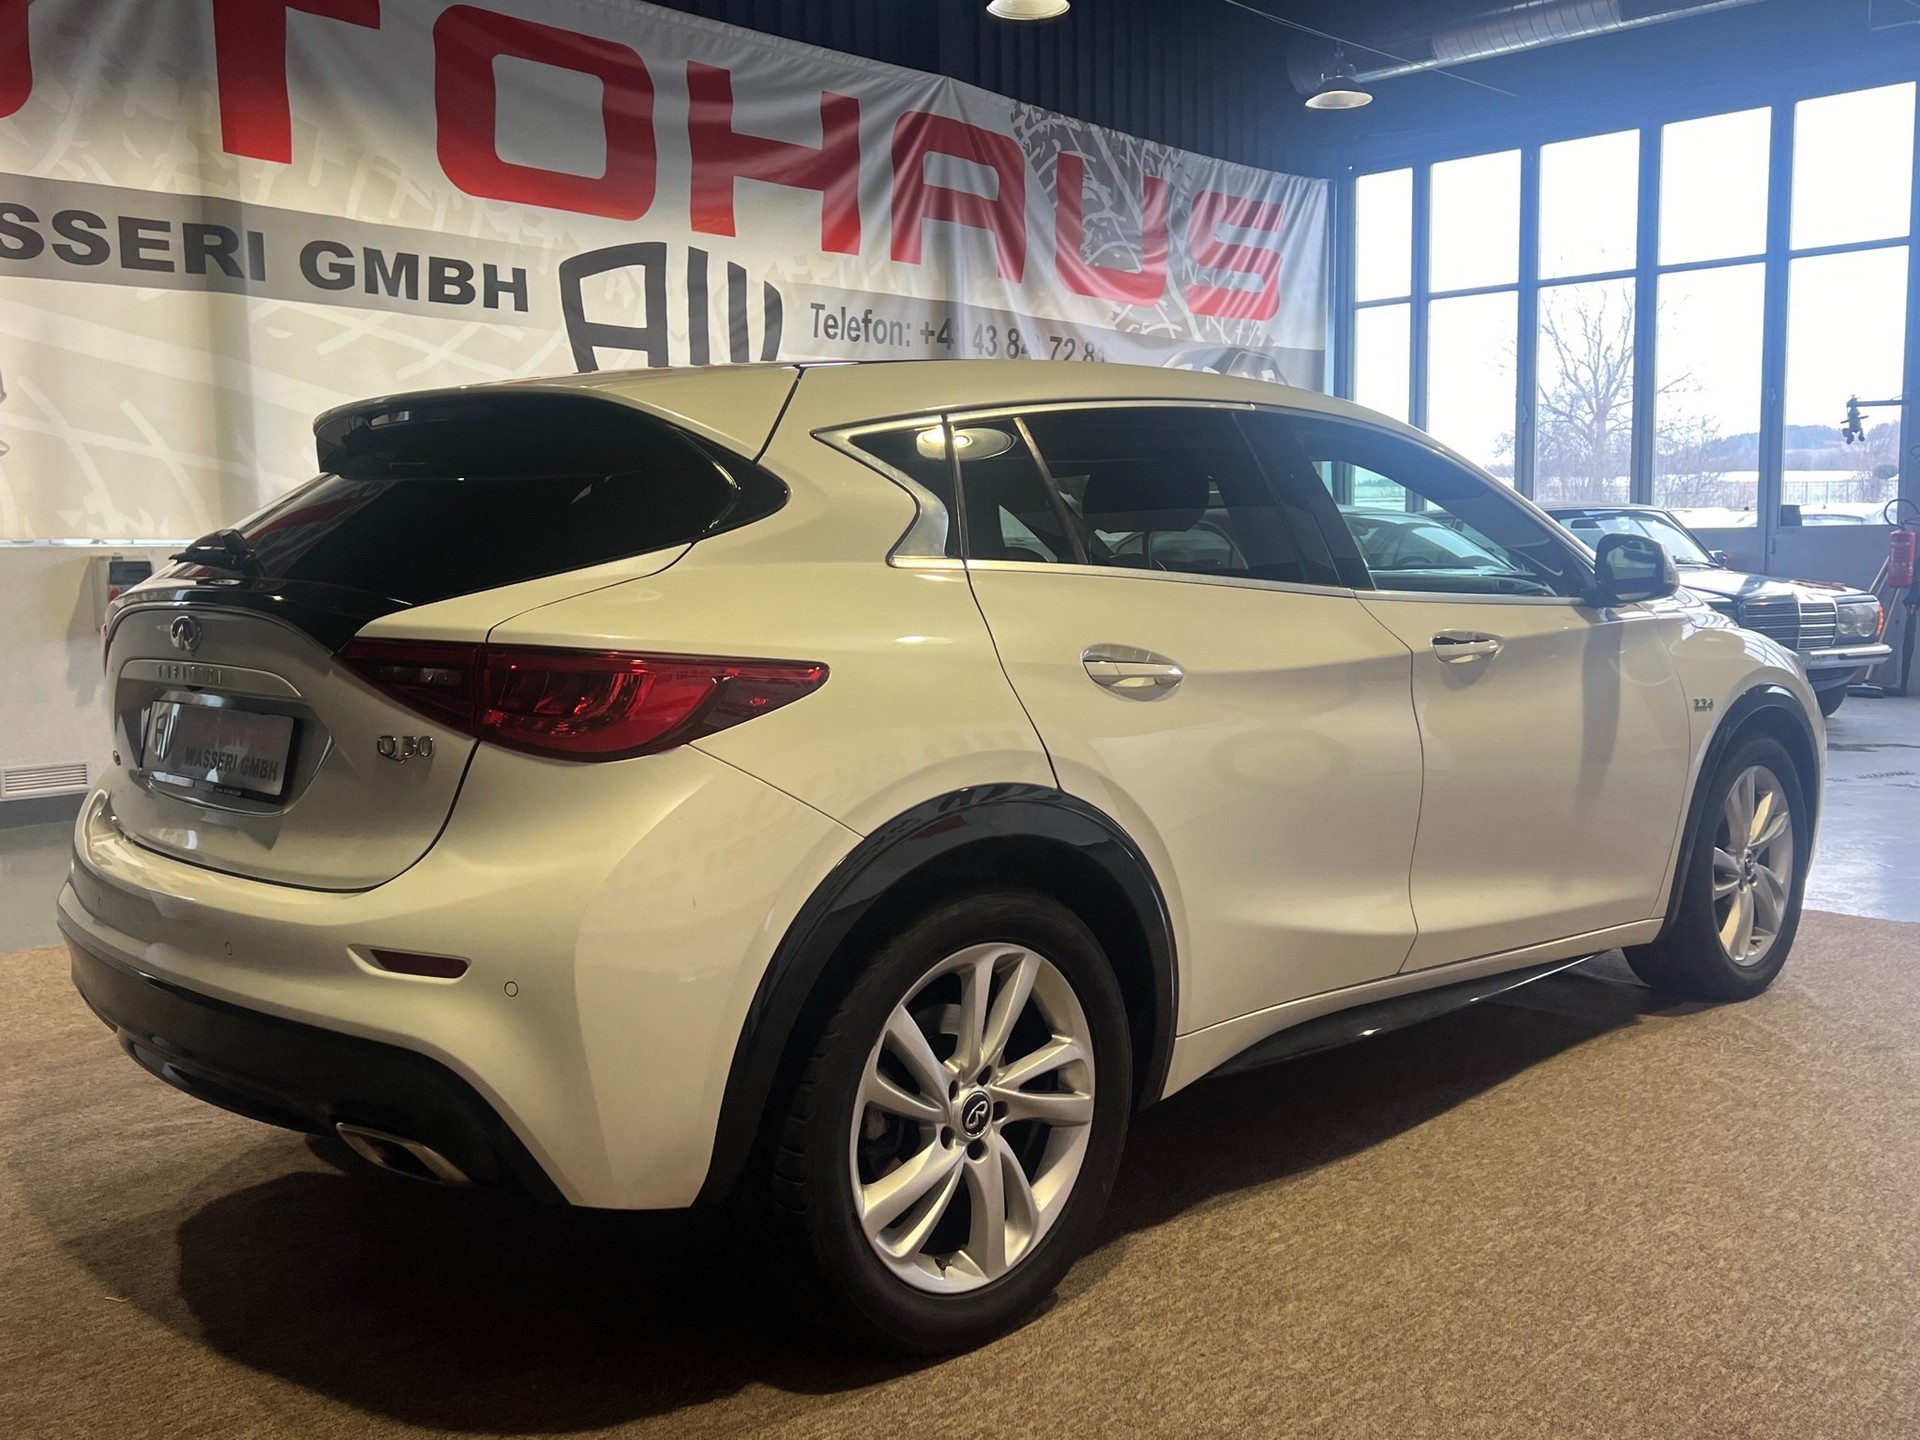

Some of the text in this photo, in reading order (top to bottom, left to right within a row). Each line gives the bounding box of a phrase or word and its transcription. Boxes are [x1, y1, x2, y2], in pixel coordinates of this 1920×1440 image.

[0, 0, 1285, 322] TOHAUS
[300, 240, 530, 313] GMBH
[810, 302, 911, 347] Telefon:
[972, 323, 998, 357] 43
[185, 746, 279, 781] WASSERI GMBH
